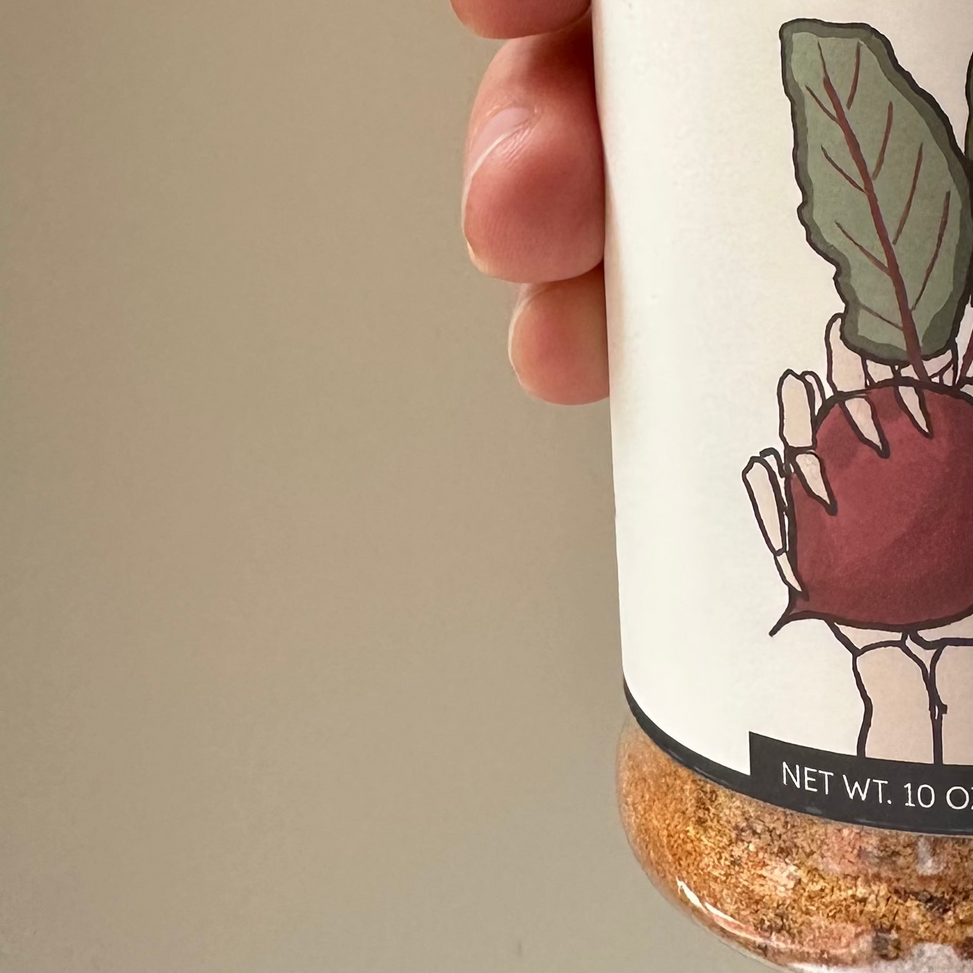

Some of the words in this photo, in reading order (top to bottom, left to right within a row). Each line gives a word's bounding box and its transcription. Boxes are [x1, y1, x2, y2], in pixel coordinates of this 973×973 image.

[782, 761, 834, 796] NET
[842, 774, 892, 805] WT.
[903, 782, 936, 809] 10
